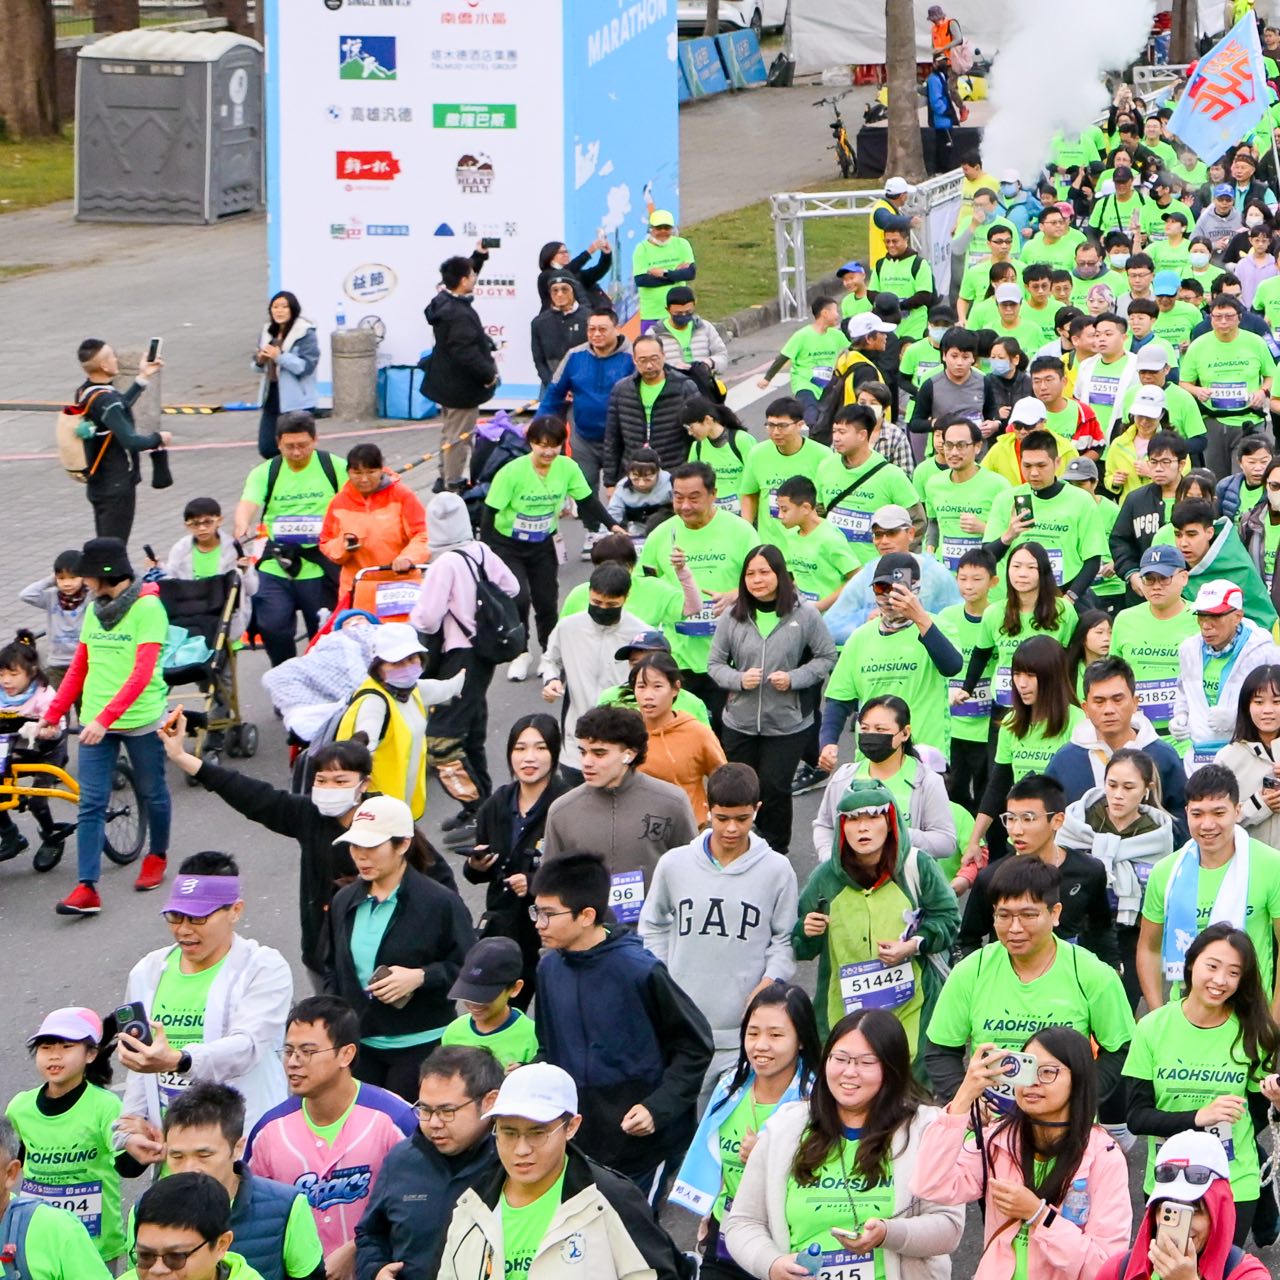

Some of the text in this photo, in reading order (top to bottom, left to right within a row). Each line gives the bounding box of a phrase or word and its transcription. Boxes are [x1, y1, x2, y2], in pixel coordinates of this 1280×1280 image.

[861, 662, 918, 674] KAOHSIUNG
[1138, 690, 1177, 703] 51852
[678, 898, 762, 942] GAP
[852, 970, 904, 994] 51442
[1156, 1067, 1245, 1084] KAOHSIUNG
